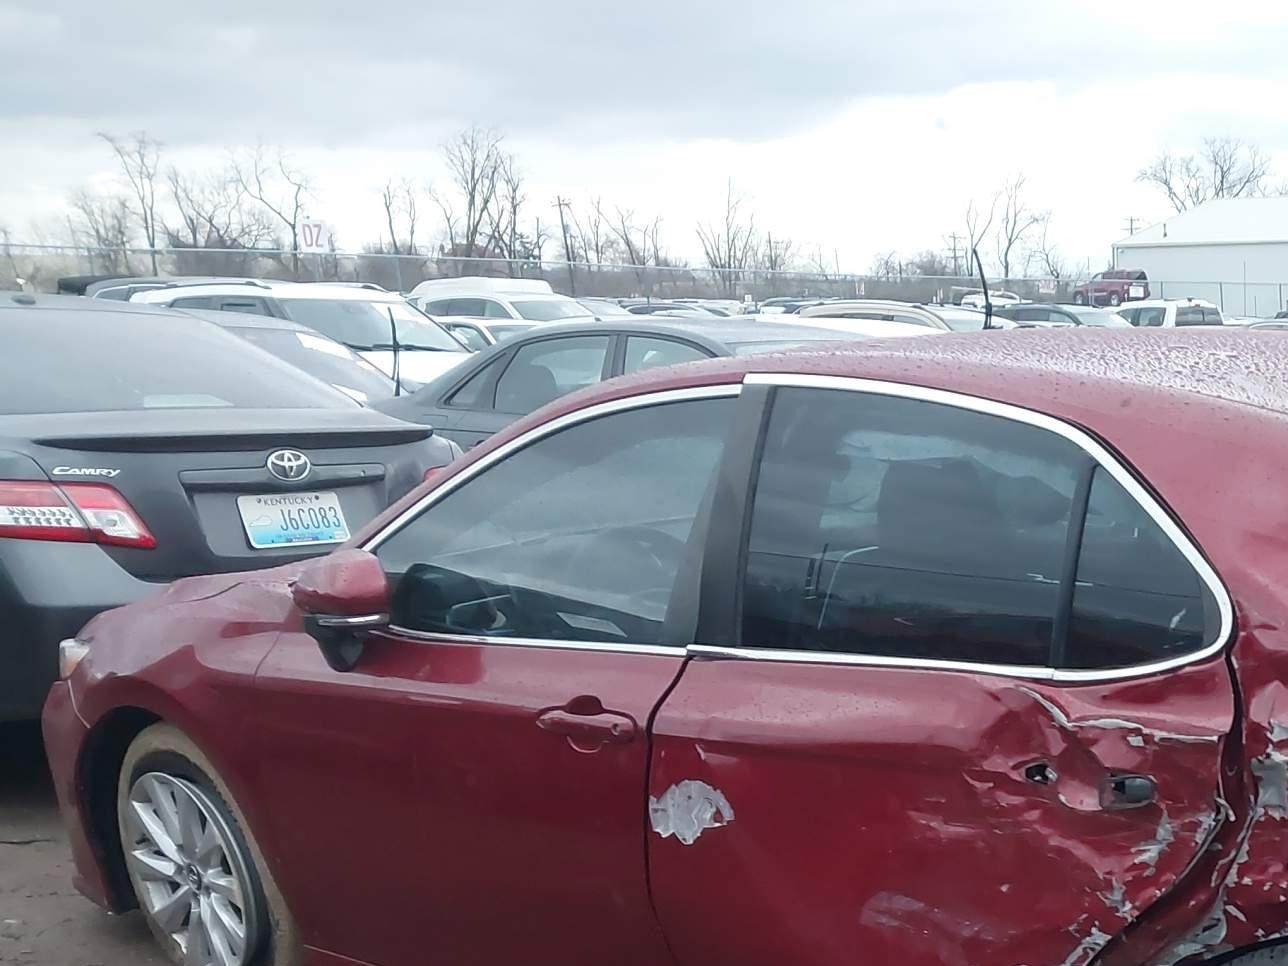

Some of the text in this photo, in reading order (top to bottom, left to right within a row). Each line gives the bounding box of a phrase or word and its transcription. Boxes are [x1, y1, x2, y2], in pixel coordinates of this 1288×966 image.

[53, 466, 120, 477] CAMRY
[263, 496, 313, 506] KENTUCKY
[280, 506, 341, 531] J6C083
